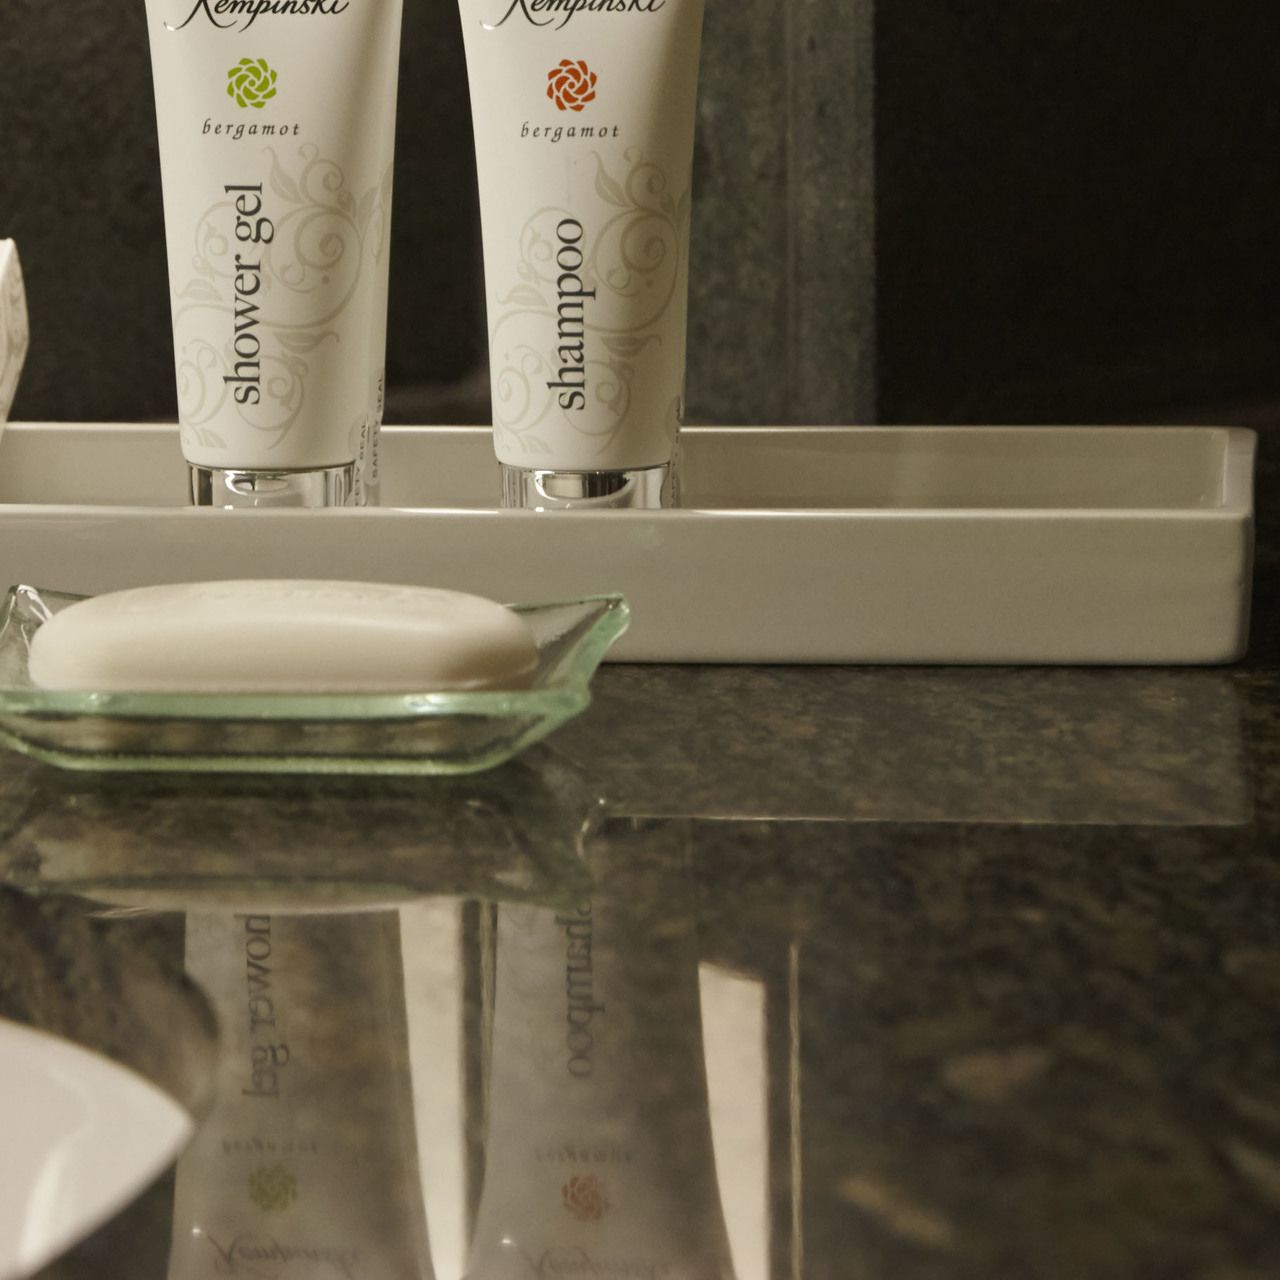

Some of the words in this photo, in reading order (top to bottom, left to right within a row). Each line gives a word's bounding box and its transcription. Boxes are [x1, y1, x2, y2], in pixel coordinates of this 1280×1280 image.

[202, 118, 300, 141] bergamot
[521, 121, 619, 143] bergamot
[224, 182, 274, 245] gel
[223, 254, 262, 406] shower
[545, 218, 597, 411] shampoo
